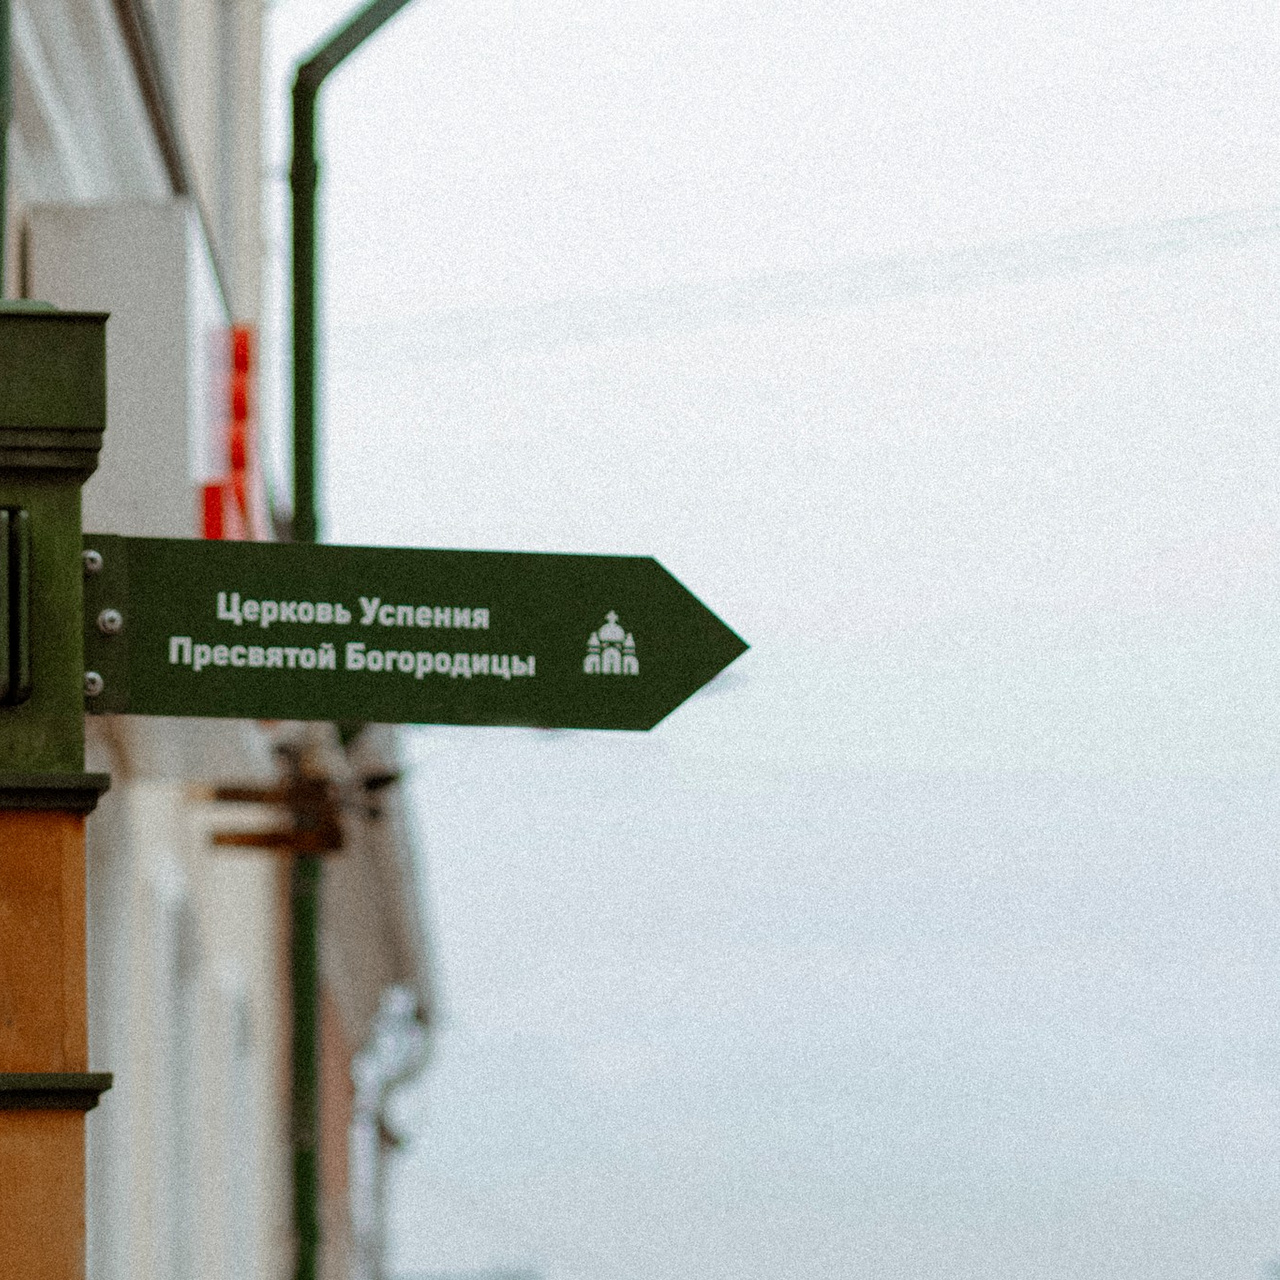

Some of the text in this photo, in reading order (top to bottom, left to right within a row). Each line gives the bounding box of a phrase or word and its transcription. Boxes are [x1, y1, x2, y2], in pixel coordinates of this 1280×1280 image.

[217, 592, 490, 629] Церковь Успения
[169, 636, 536, 680] Пресвятой Богородицы
